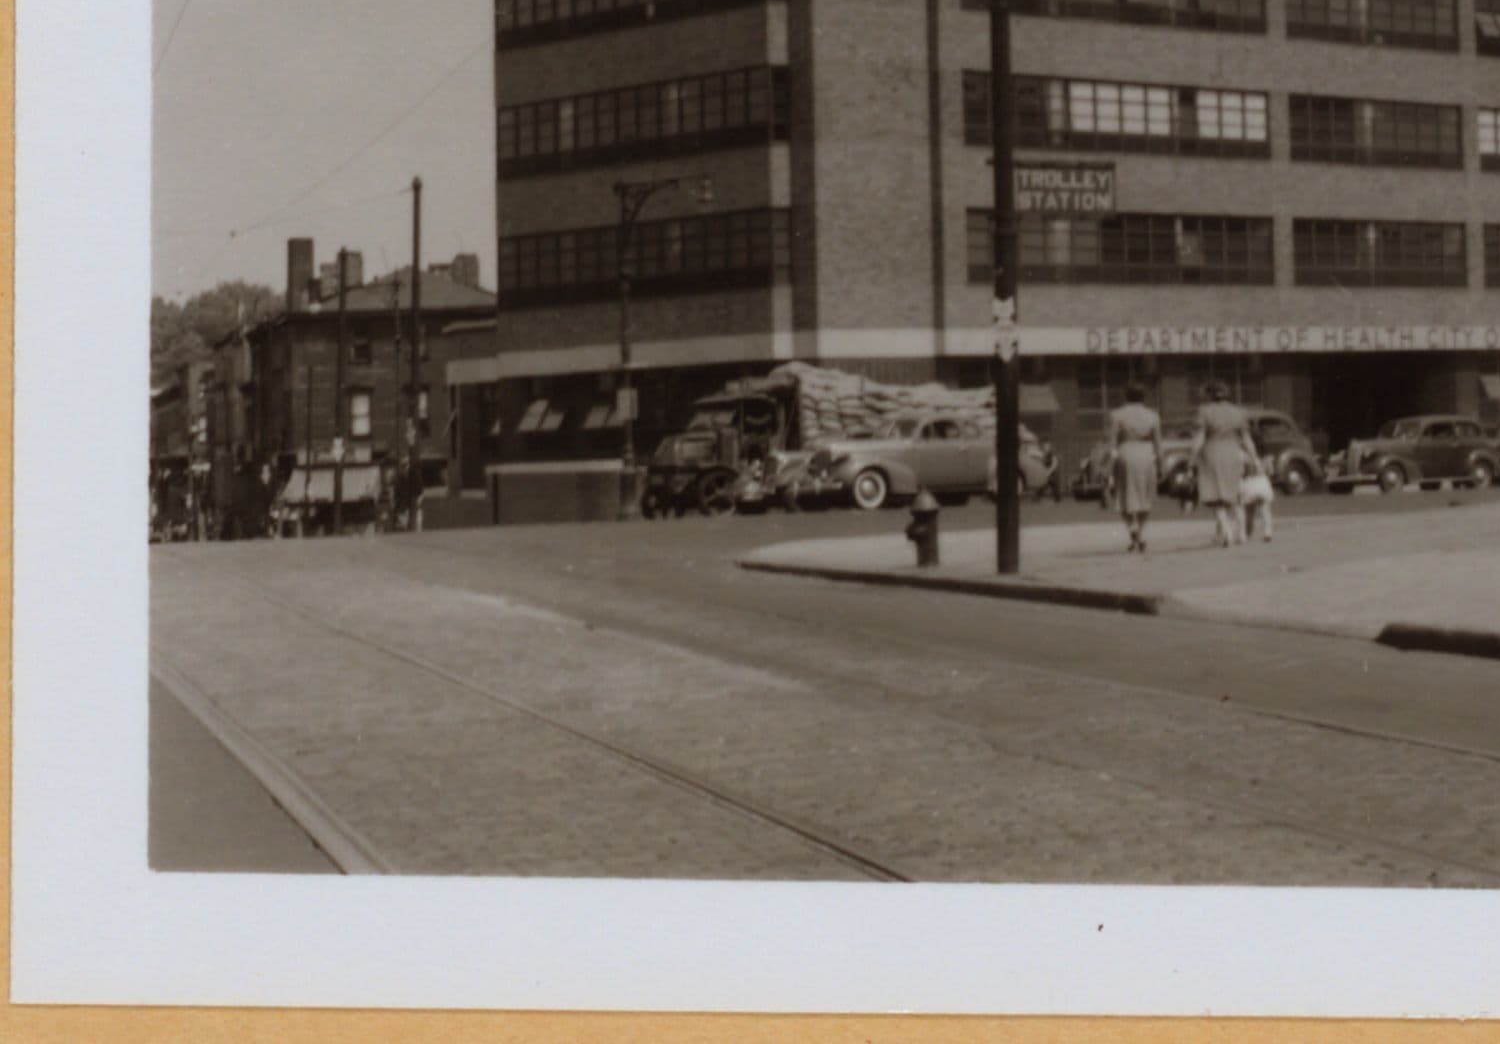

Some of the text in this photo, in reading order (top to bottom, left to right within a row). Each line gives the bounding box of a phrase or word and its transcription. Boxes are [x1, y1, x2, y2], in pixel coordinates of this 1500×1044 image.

[1018, 169, 1110, 188] TROLLEY
[1016, 192, 1112, 210] STATION
[1085, 328, 1265, 353] DEPARTMENT
[1276, 328, 1309, 350] OF
[1324, 327, 1413, 351] HEALTH
[1427, 326, 1473, 350] CITY
